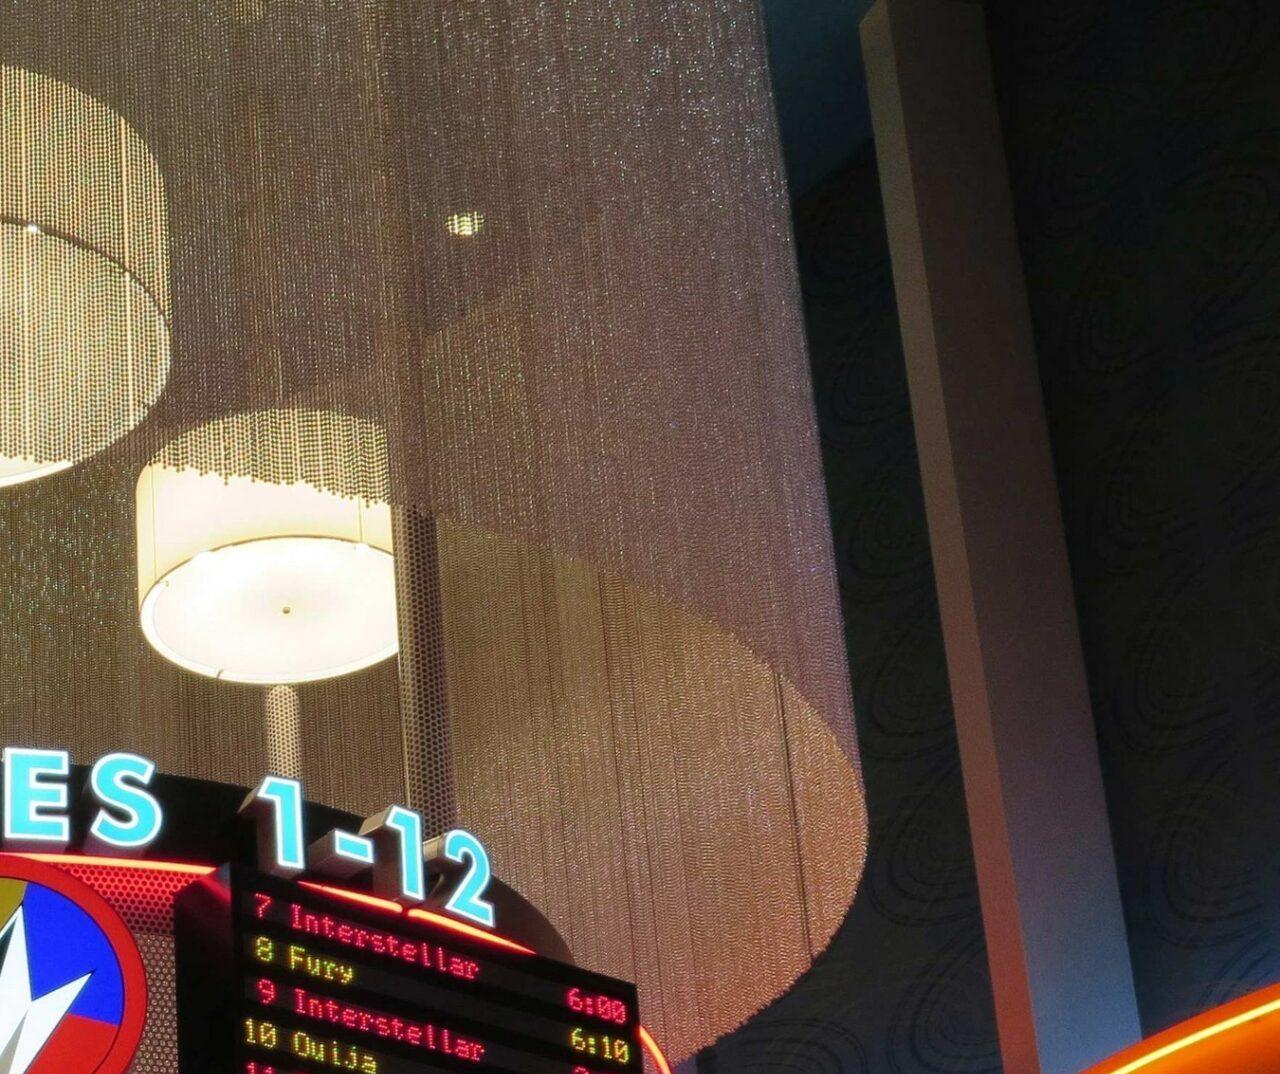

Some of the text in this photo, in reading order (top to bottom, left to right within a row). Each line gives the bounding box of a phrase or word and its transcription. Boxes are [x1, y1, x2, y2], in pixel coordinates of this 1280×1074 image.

[258, 776, 495, 927] 1-12
[255, 893, 626, 1024] 7 Interstellar 6:00
[256, 937, 629, 1063] 8 Fury 6:10
[257, 979, 276, 1004] 9
[295, 988, 484, 1061] Interstellar
[246, 1019, 276, 1048] 10
[293, 1032, 376, 1074] Ouija
